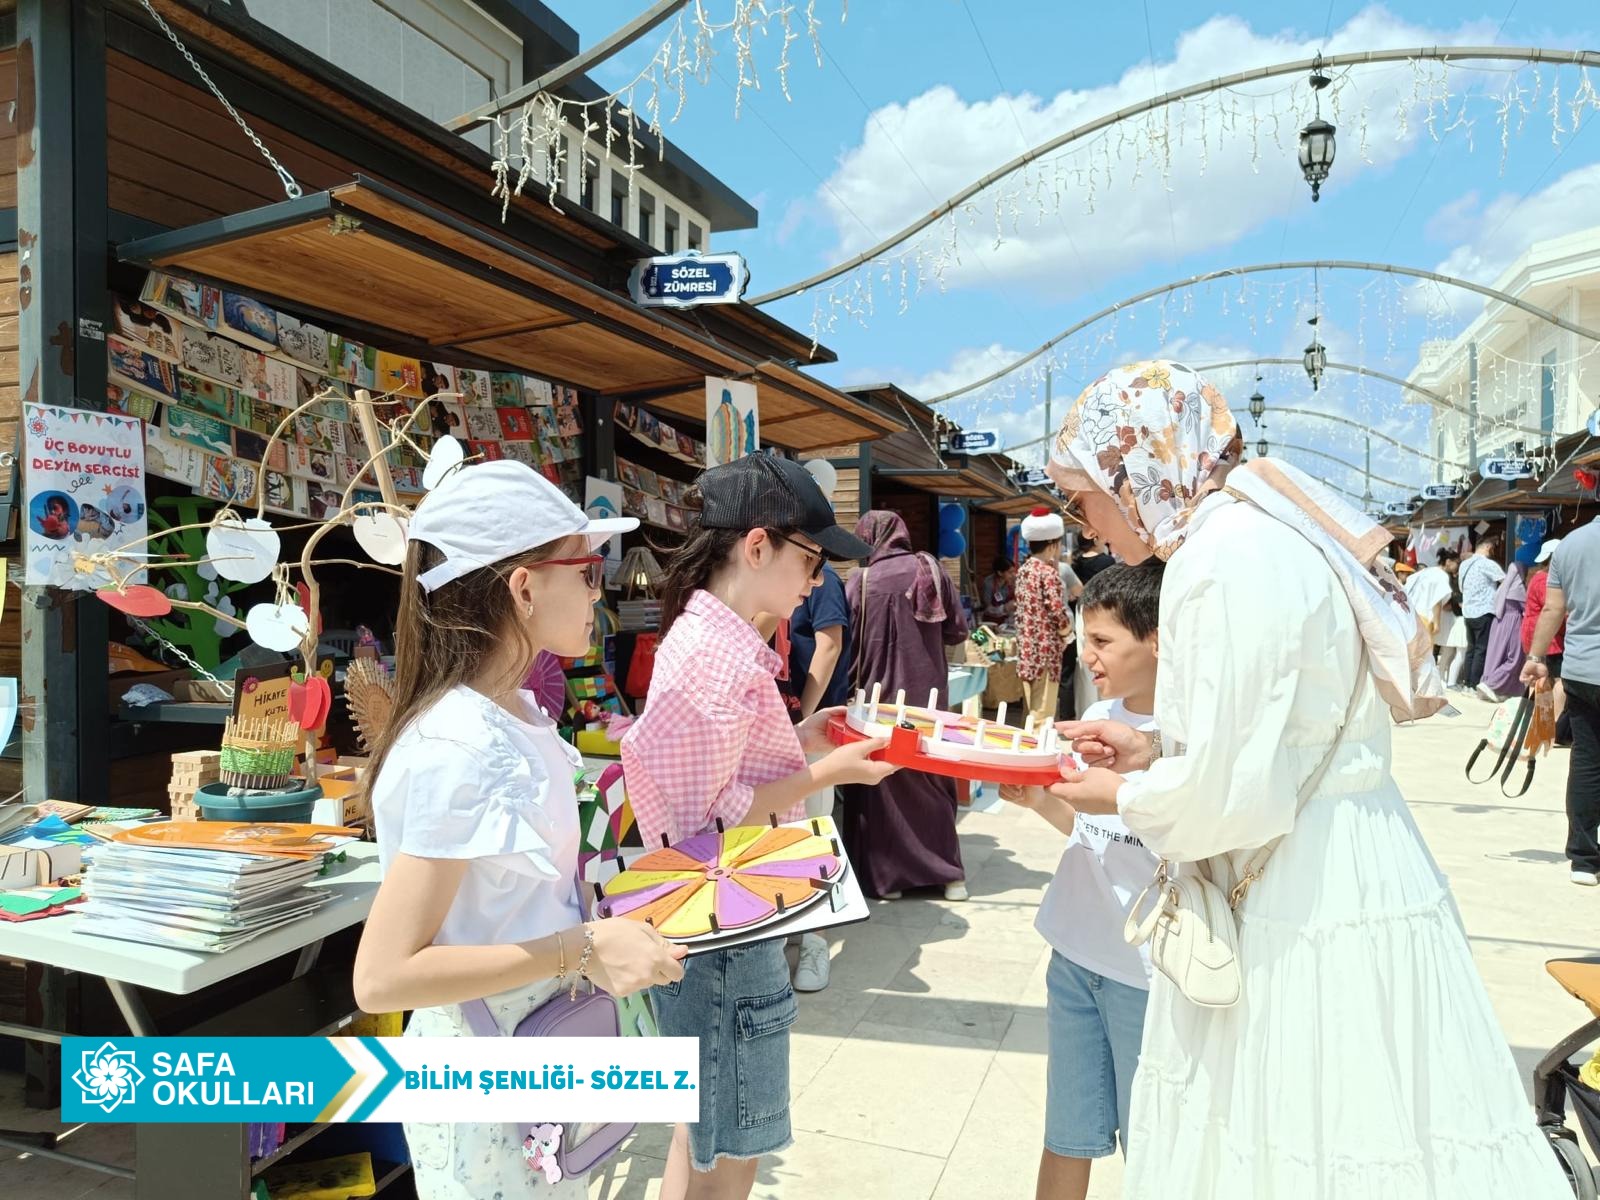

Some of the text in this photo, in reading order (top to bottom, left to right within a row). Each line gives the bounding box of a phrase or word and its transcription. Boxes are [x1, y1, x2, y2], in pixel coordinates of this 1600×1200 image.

[671, 266, 710, 279] SÖZEL
[663, 280, 717, 293] ZÜMRESİ
[44, 437, 132, 459] ÜÇ BOYUTLU
[32, 458, 140, 478] DEYİM SERGİSİ
[254, 688, 288, 707] HİKAYE
[264, 705, 289, 717] KUTU
[344, 805, 357, 817] NE
[1083, 822, 1146, 848] ETS THE MIN
